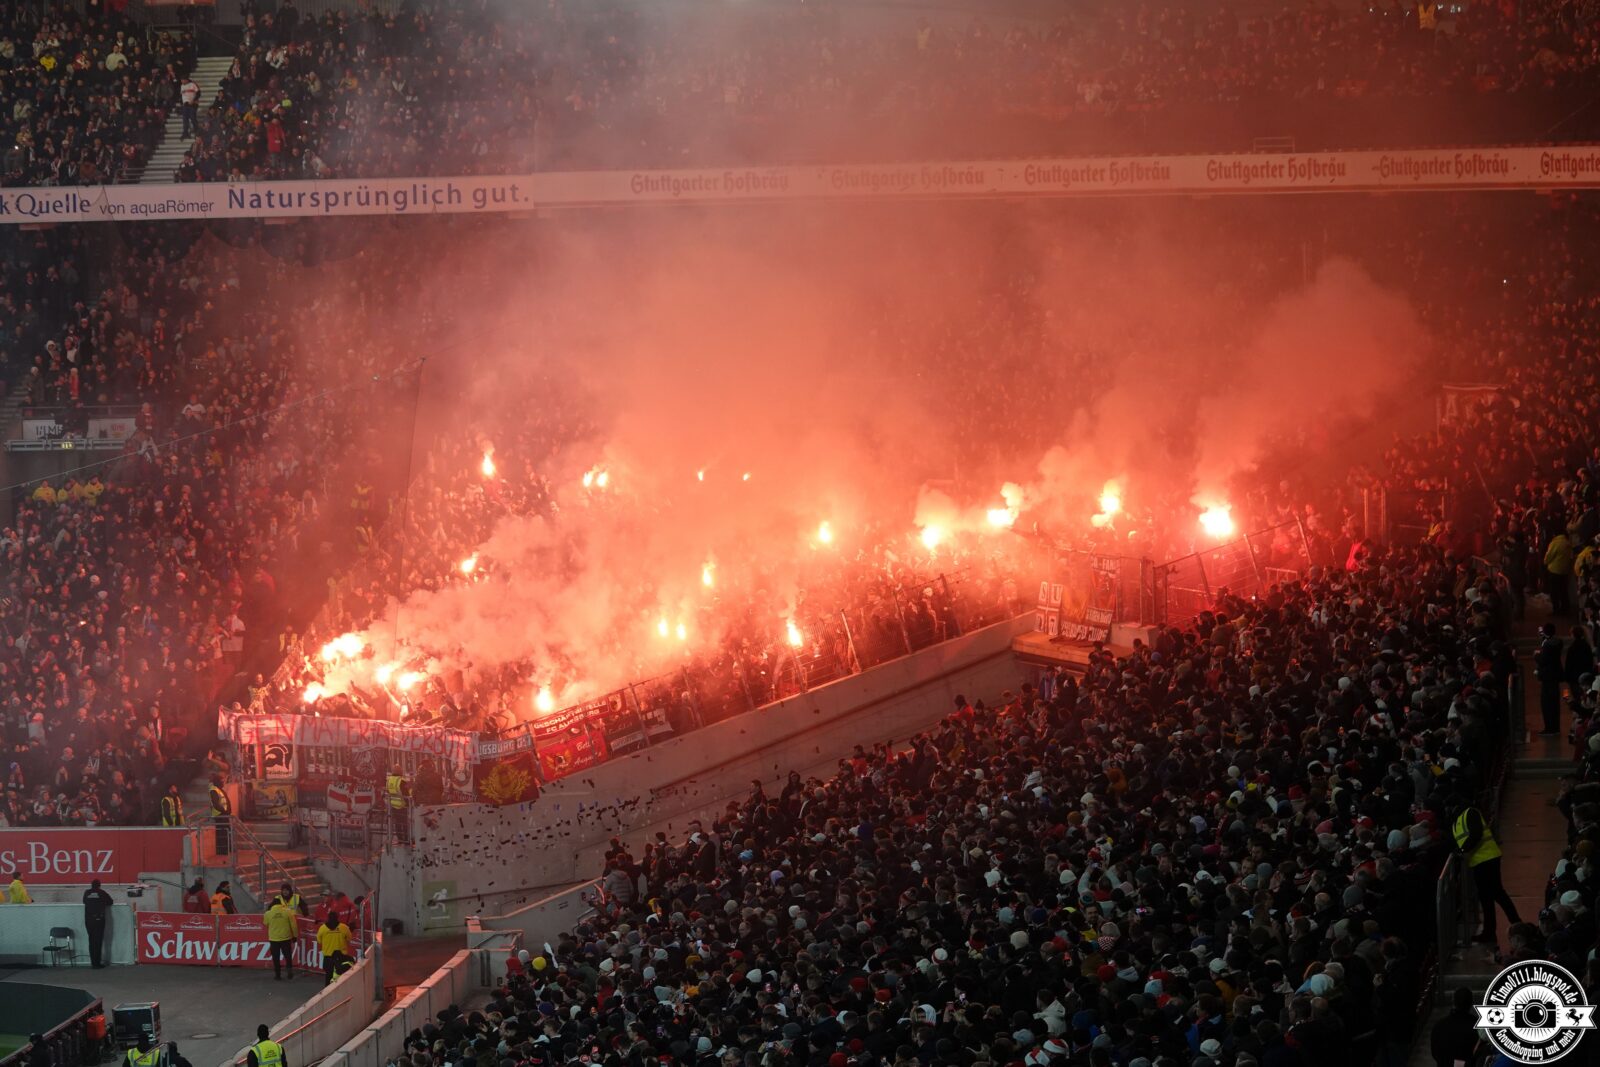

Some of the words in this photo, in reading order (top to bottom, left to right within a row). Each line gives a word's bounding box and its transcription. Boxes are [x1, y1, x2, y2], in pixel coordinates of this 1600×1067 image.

[920, 165, 985, 189] Hofbräu
[1024, 162, 1105, 187] Stuttgarter
[1109, 160, 1170, 185] Hofbräu
[1206, 159, 1283, 184] Stuttgarter
[1287, 157, 1346, 181] Hofbräu
[1379, 155, 1450, 181] Stuttgarter
[1453, 153, 1509, 179] Hofbräu
[630, 173, 719, 197] Stuttgarter
[723, 170, 789, 194] Hofbräu
[100, 204, 126, 216] von
[130, 199, 214, 217] aquaRömer
[227, 183, 462, 212] Natursprünglich
[472, 183, 529, 209] gut.
[0, 841, 114, 874] s-Benz
